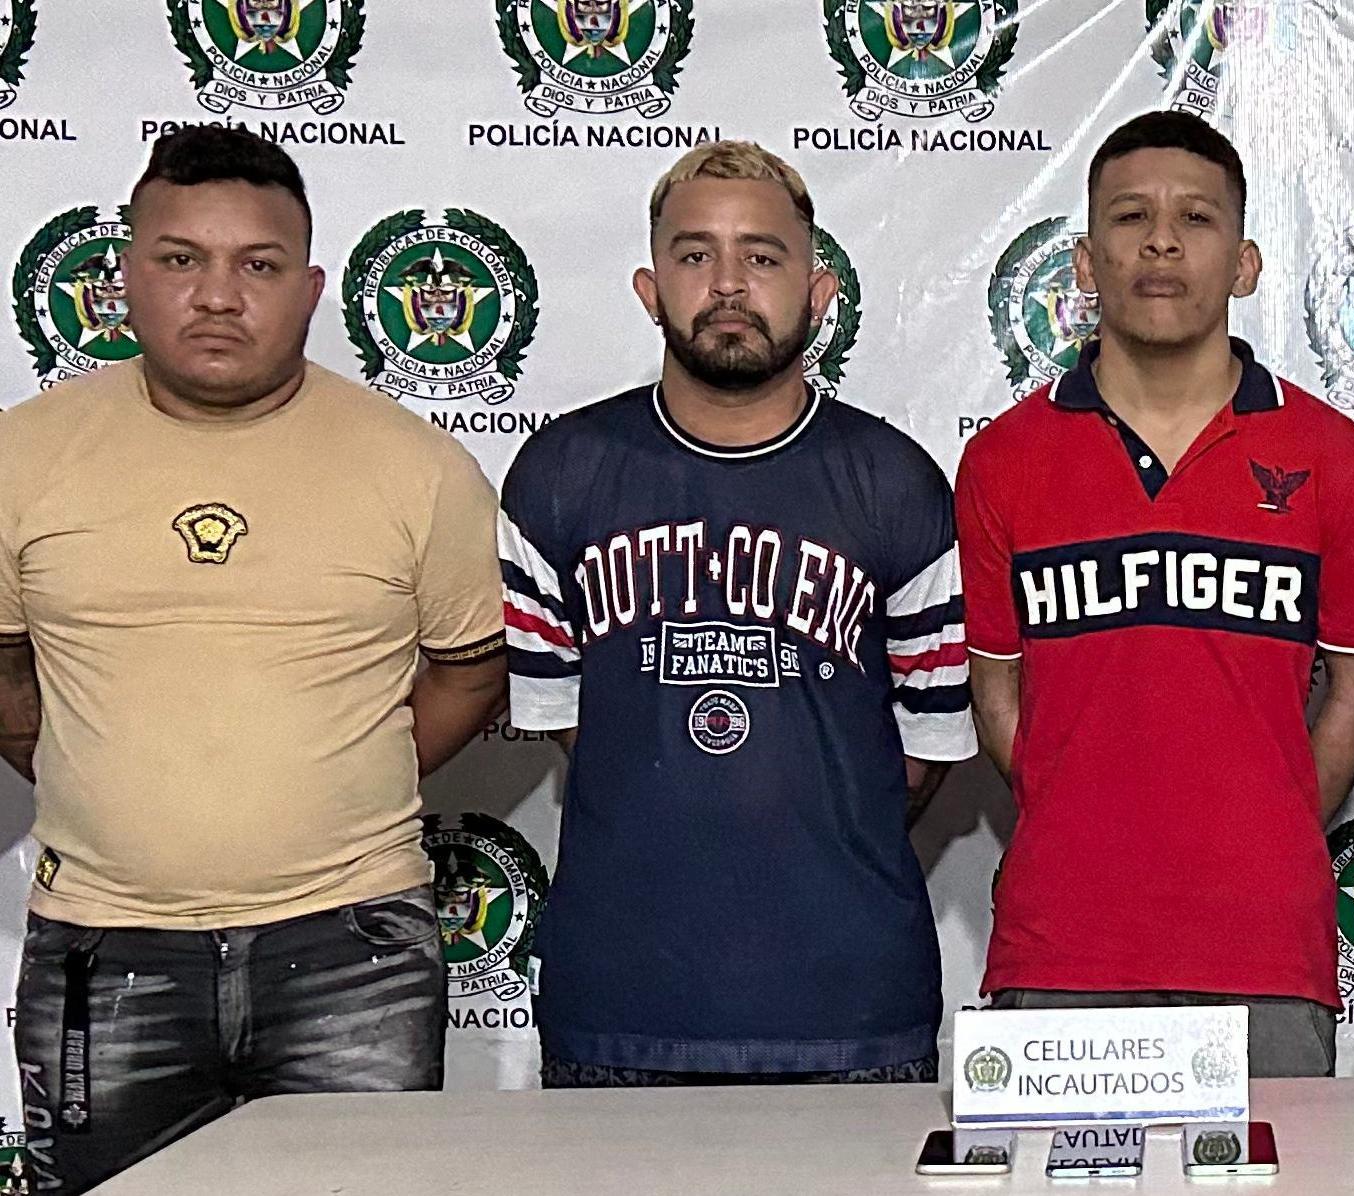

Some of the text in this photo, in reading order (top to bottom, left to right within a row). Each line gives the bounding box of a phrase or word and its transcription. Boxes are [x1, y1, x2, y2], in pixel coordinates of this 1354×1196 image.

[205, 44, 333, 86] POLICIA NACIONAL
[534, 49, 661, 91] POLICIA NACIONAL
[860, 53, 985, 95] POLICIA NACIONAL
[214, 81, 329, 105] DIOS Y PATRIA
[541, 86, 655, 109] DIOS Y PATRIA
[866, 90, 977, 113] DIOS Y PATRIA
[1, 118, 77, 141] ONAL
[261, 121, 405, 145] NACIONAL
[468, 120, 579, 147] POLICÍA
[794, 125, 1052, 152] POLICÍA NACIONAL
[36, 225, 119, 294] REPUBLICA DE
[366, 229, 513, 298] REPUBLICA DE COLOMBIA
[378, 336, 505, 378] POLICIA NACIONAL
[801, 339, 827, 370] ONAL
[384, 373, 498, 395] DIOS Y PATRIA
[430, 411, 554, 434] NACIONA
[1020, 550, 1302, 625] HILFIGER
[694, 631, 746, 655] TEAM
[671, 654, 769, 678] FANATIC'S
[442, 832, 524, 898] DE COLOMBIA
[457, 935, 518, 976] NACIONAL
[460, 972, 510, 992] PATRIA
[446, 1007, 534, 1029] NACIO
[1023, 1038, 1166, 1062] CELULARES
[1018, 1071, 1185, 1096] INCAUTADOS
[6, 1136, 25, 1146] DE
